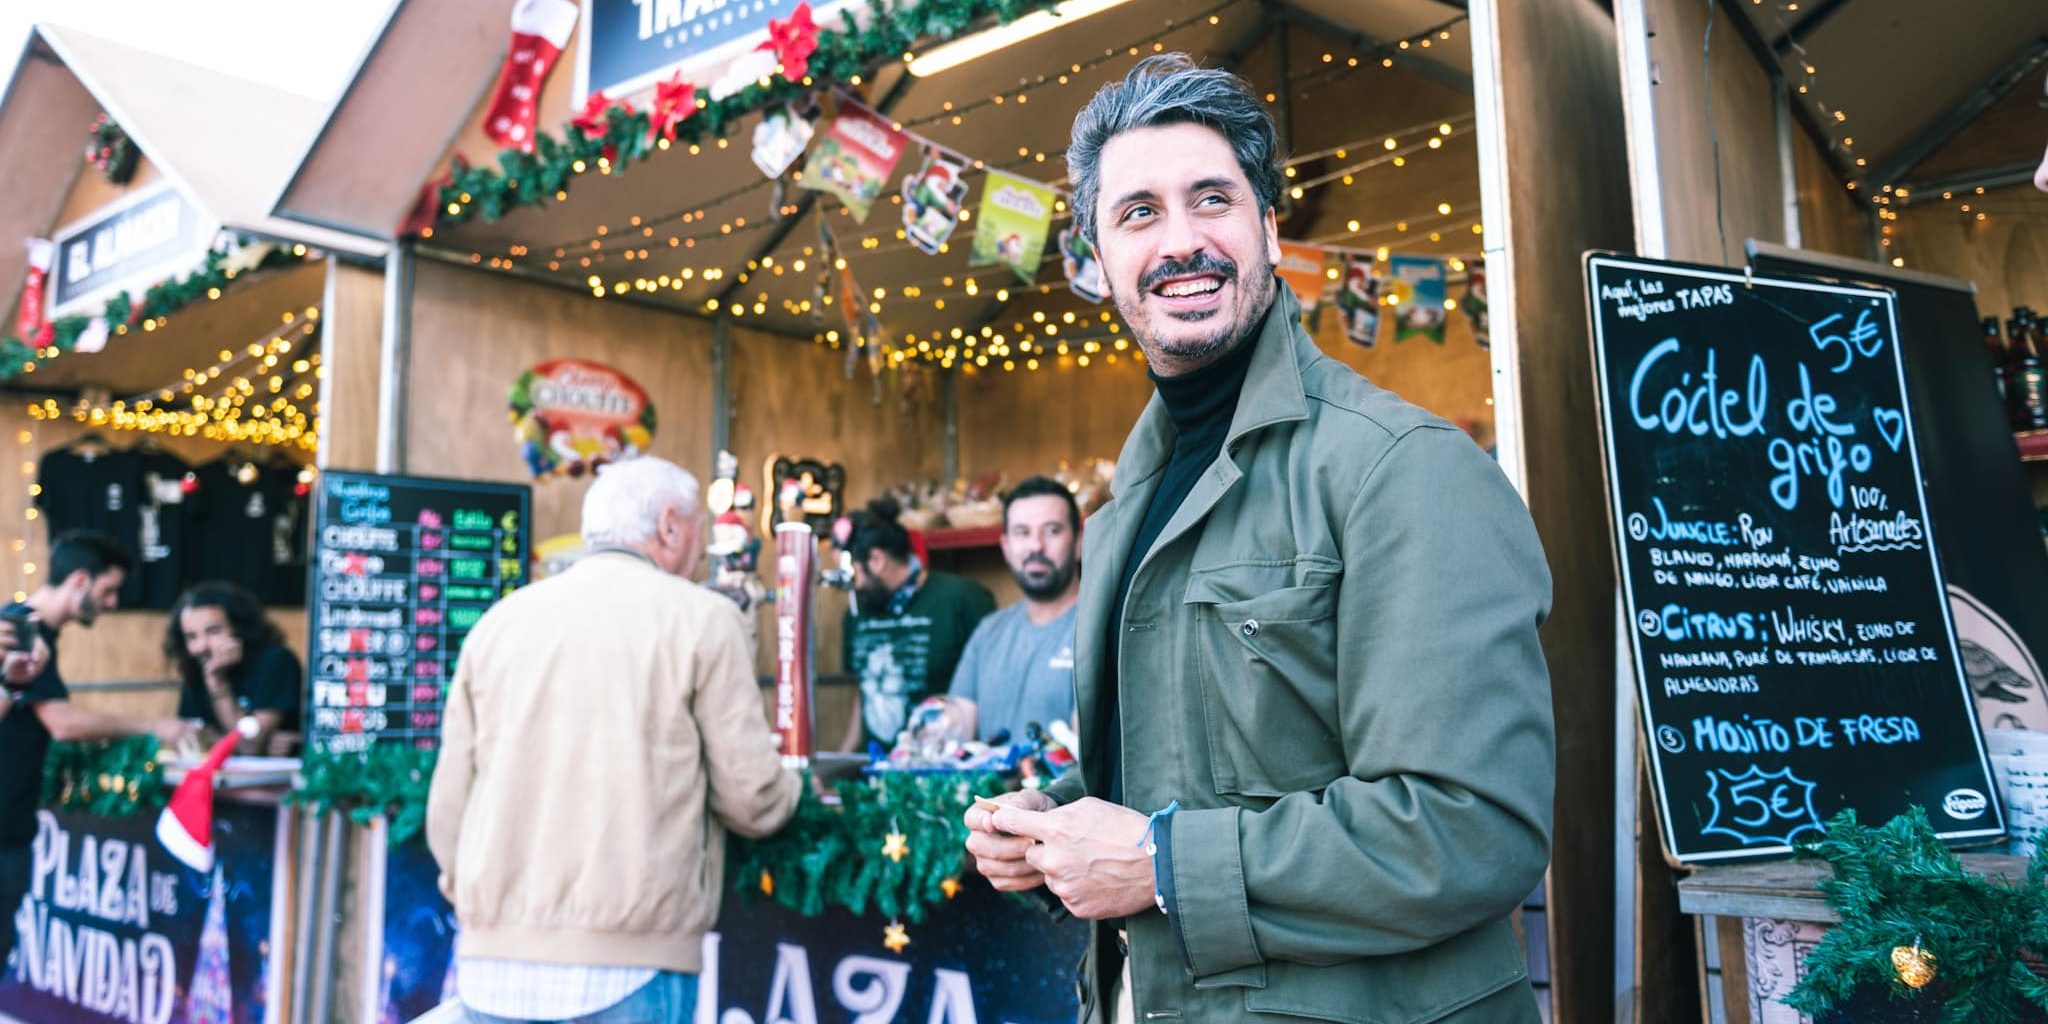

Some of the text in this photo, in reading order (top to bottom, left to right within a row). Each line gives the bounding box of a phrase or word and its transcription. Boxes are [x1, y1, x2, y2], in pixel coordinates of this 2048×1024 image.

[1601, 279, 1664, 306] Aquí, las
[1617, 284, 1733, 322] mejores TAPAS
[1808, 309, 1884, 374] 5€
[1629, 337, 1857, 440] Cóctel de
[1767, 434, 1873, 511] grifo
[1850, 485, 1889, 511] 100%
[1652, 569, 1679, 586] DE
[1894, 621, 1915, 635] DE
[1663, 675, 1760, 698] ALMENDRAS
[1794, 717, 1834, 748] DE
[1839, 714, 1921, 745] FRESA
[1730, 778, 1805, 827] 5€
[31, 809, 179, 928] PLAZA DE
[7, 892, 177, 1024] NAVIDAD
